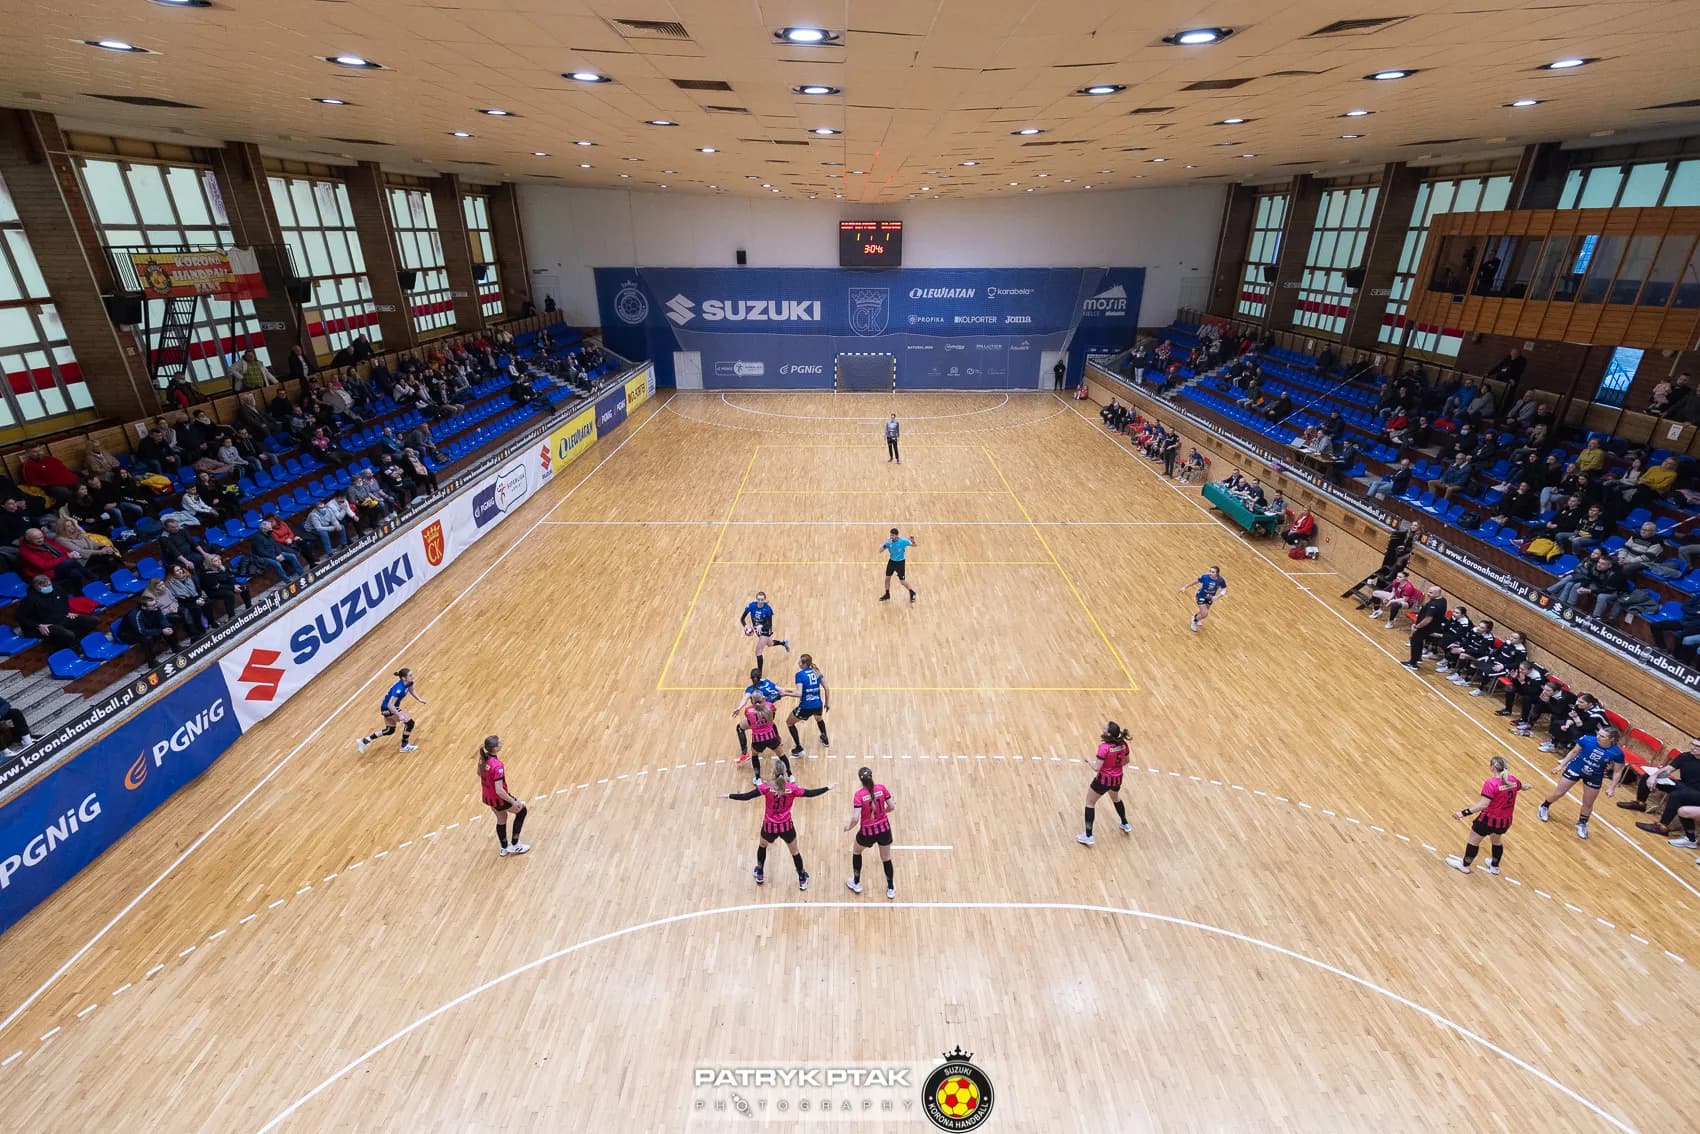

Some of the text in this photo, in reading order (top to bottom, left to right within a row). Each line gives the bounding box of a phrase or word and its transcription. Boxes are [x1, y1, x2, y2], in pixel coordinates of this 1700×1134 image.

[702, 300, 821, 321] SUZUKI
[922, 287, 975, 298] LEWIATAN
[790, 365, 823, 374] PGNiG
[290, 552, 414, 665] SUZUKI
[152, 698, 225, 767] PGNiG
[0, 792, 102, 889] PGNiG
